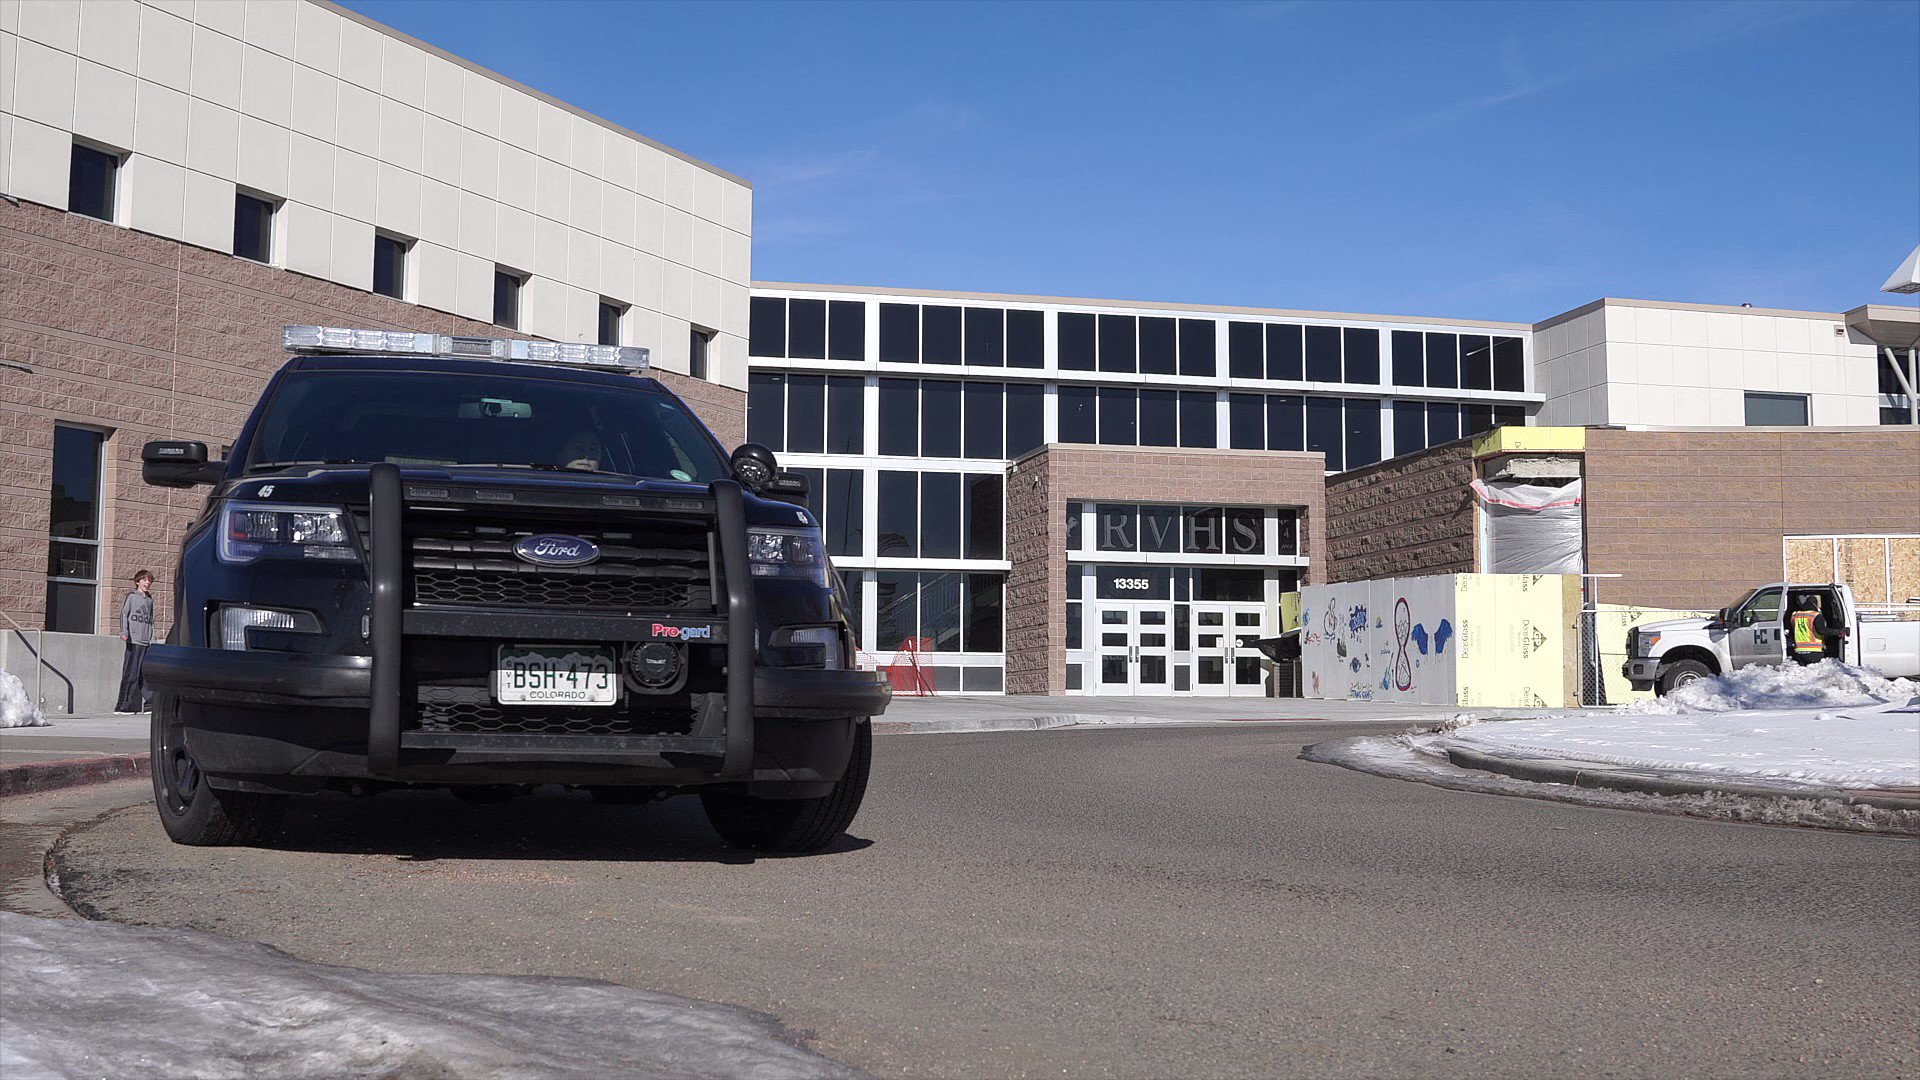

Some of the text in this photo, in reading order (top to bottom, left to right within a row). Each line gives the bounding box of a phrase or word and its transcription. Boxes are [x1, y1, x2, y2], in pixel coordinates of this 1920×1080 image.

[258, 485, 275, 497] 45
[1101, 514, 1257, 551] RVHS
[534, 538, 580, 557] Ford
[1113, 578, 1149, 590] 13355
[652, 623, 711, 640] Pro-gard
[529, 690, 586, 700] COLORADO
